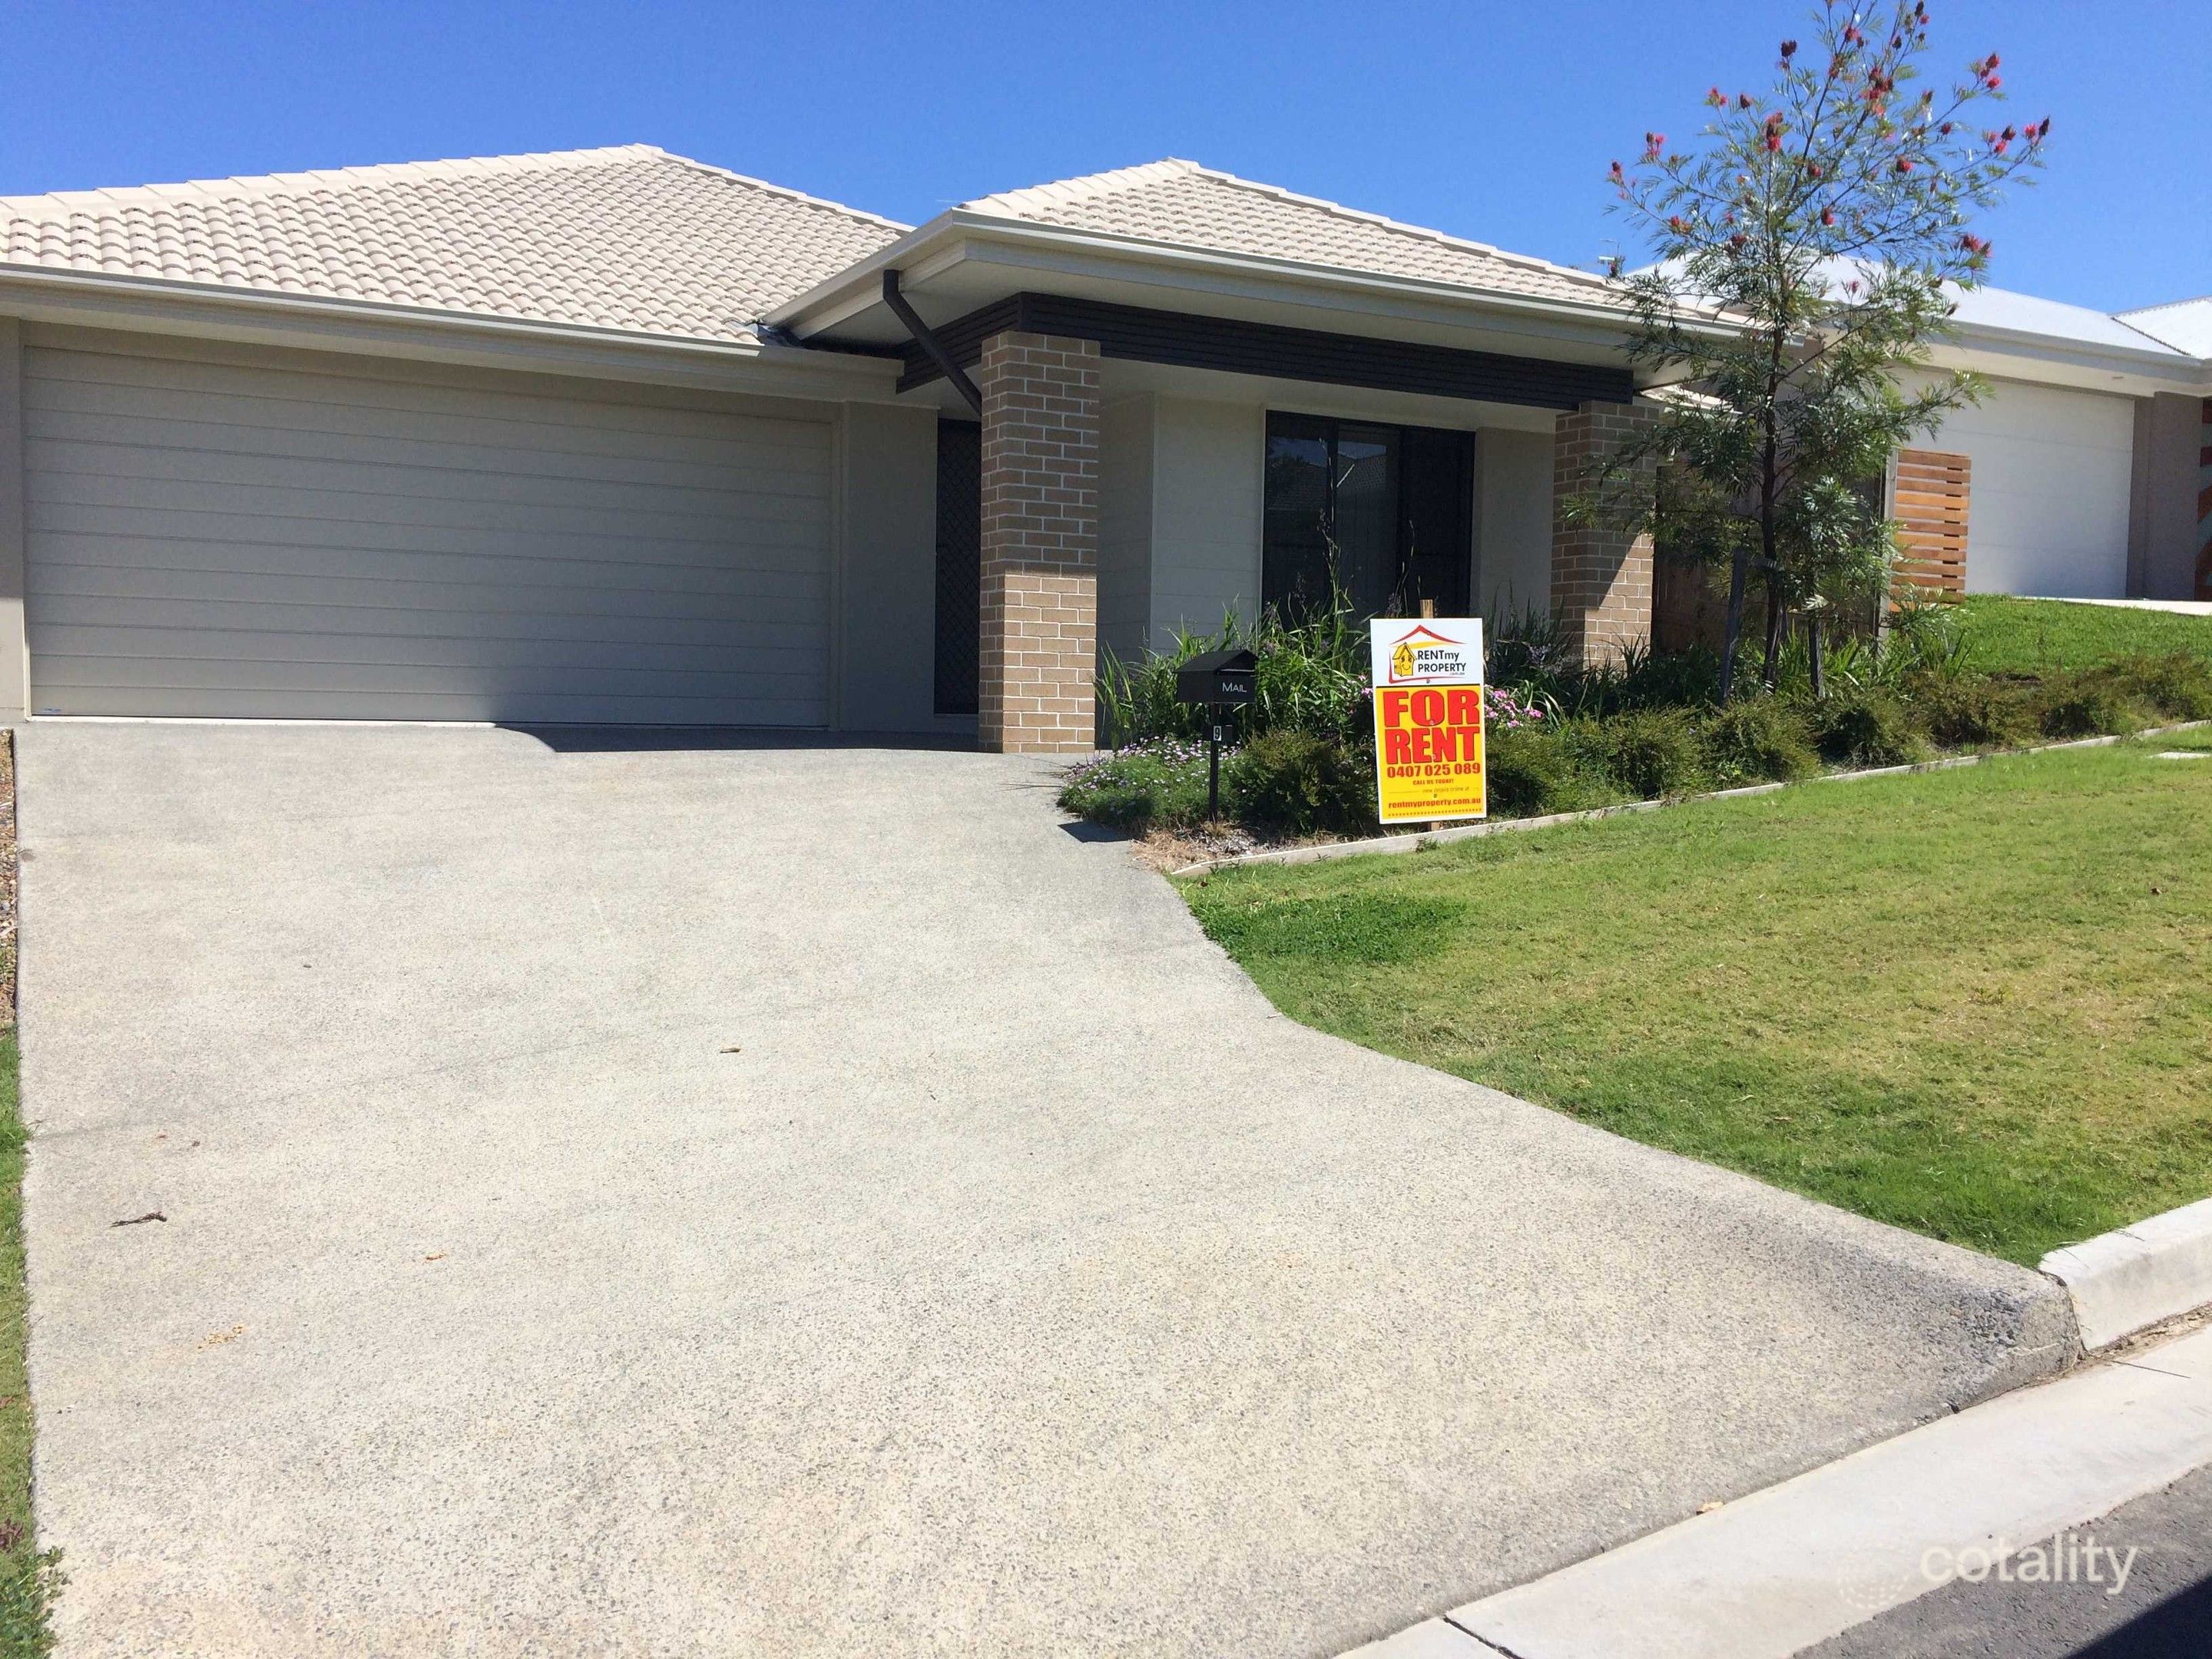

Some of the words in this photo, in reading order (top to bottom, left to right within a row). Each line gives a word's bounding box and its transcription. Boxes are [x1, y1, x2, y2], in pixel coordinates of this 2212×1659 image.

[1417, 650, 1459, 662] RENTmy
[1418, 662, 1466, 672] PROPERTY
[1222, 682, 1247, 692] MAIL
[1383, 690, 1479, 727] FOR
[1214, 727, 1220, 740] 9
[1385, 727, 1480, 764] RENT
[1387, 765, 1421, 778] 0407
[1425, 763, 1450, 776] 025
[1454, 763, 1480, 774] 089
[1389, 798, 1481, 809] rentmyproperty.com.au
